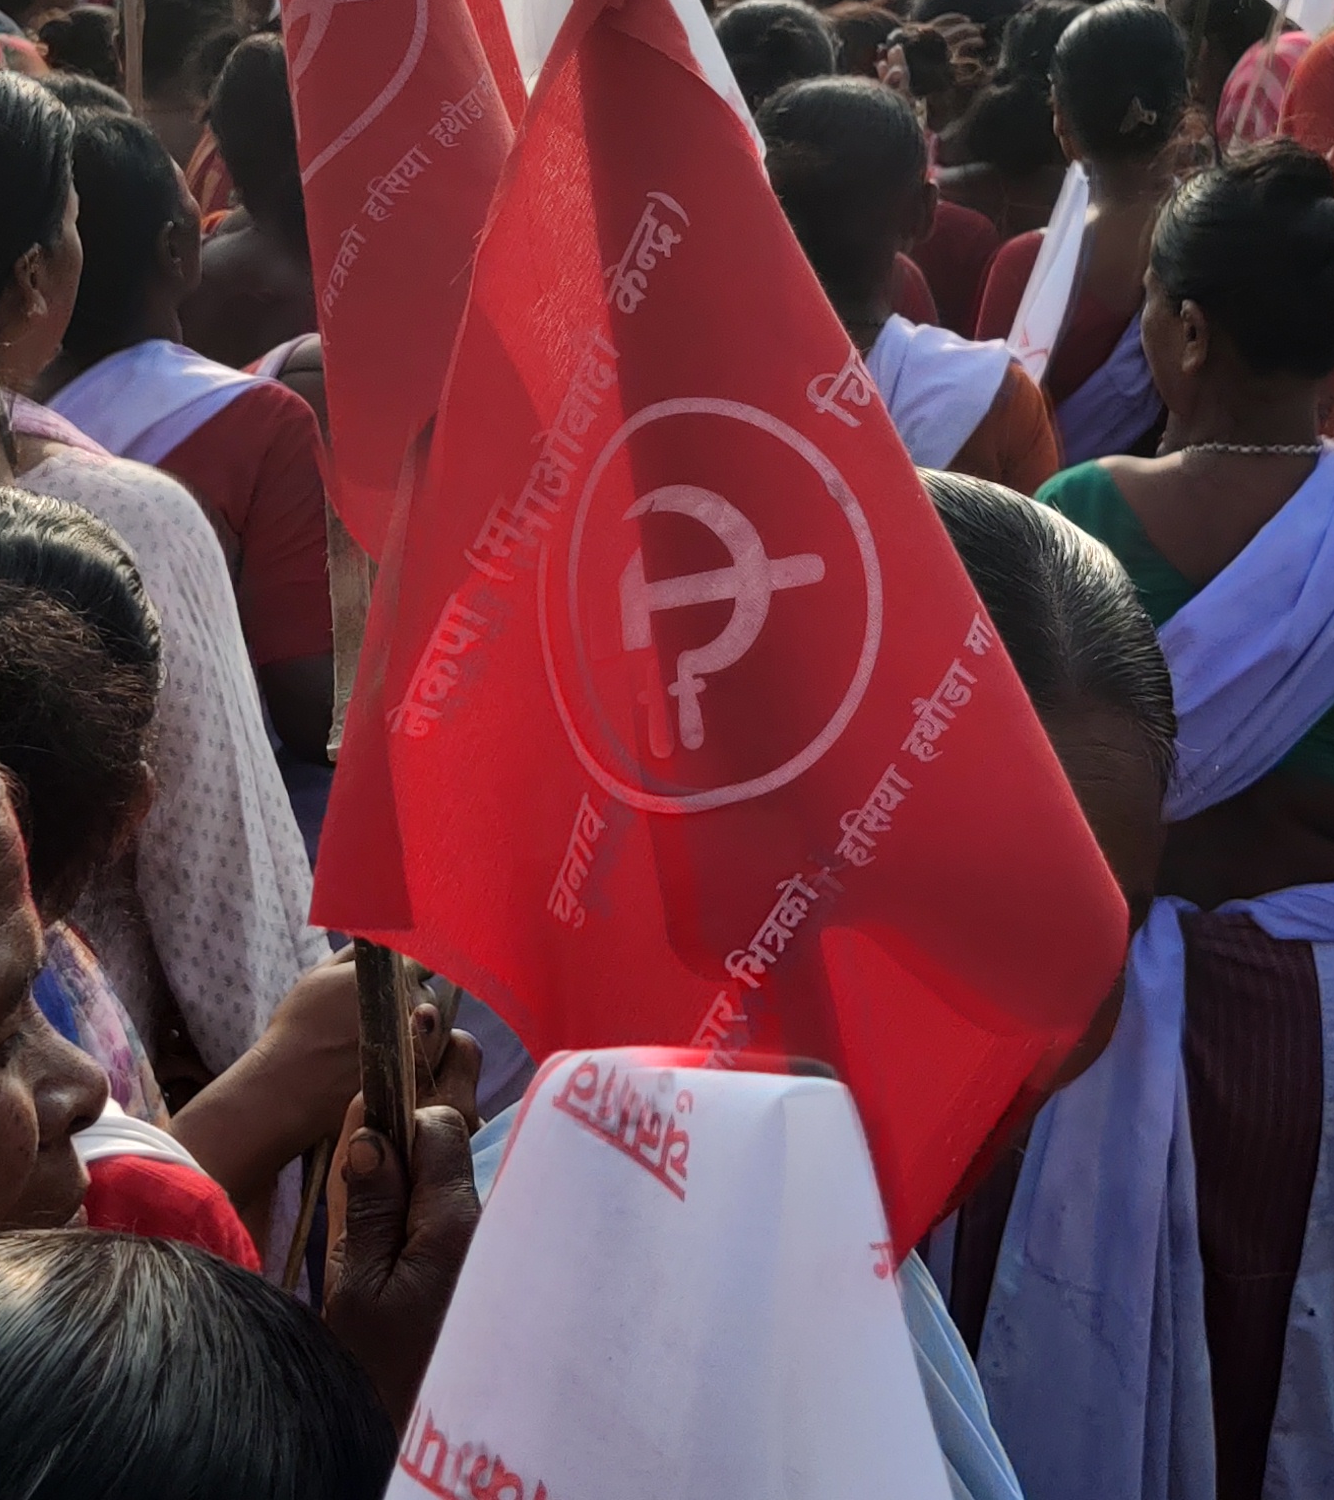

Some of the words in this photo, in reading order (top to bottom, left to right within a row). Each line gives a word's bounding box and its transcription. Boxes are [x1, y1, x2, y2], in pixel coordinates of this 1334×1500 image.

[385, 592, 488, 738] नेकपा
[603, 190, 691, 315] केन्द्र)
[547, 791, 608, 929] चुनाव
[834, 763, 914, 868] हसिया
